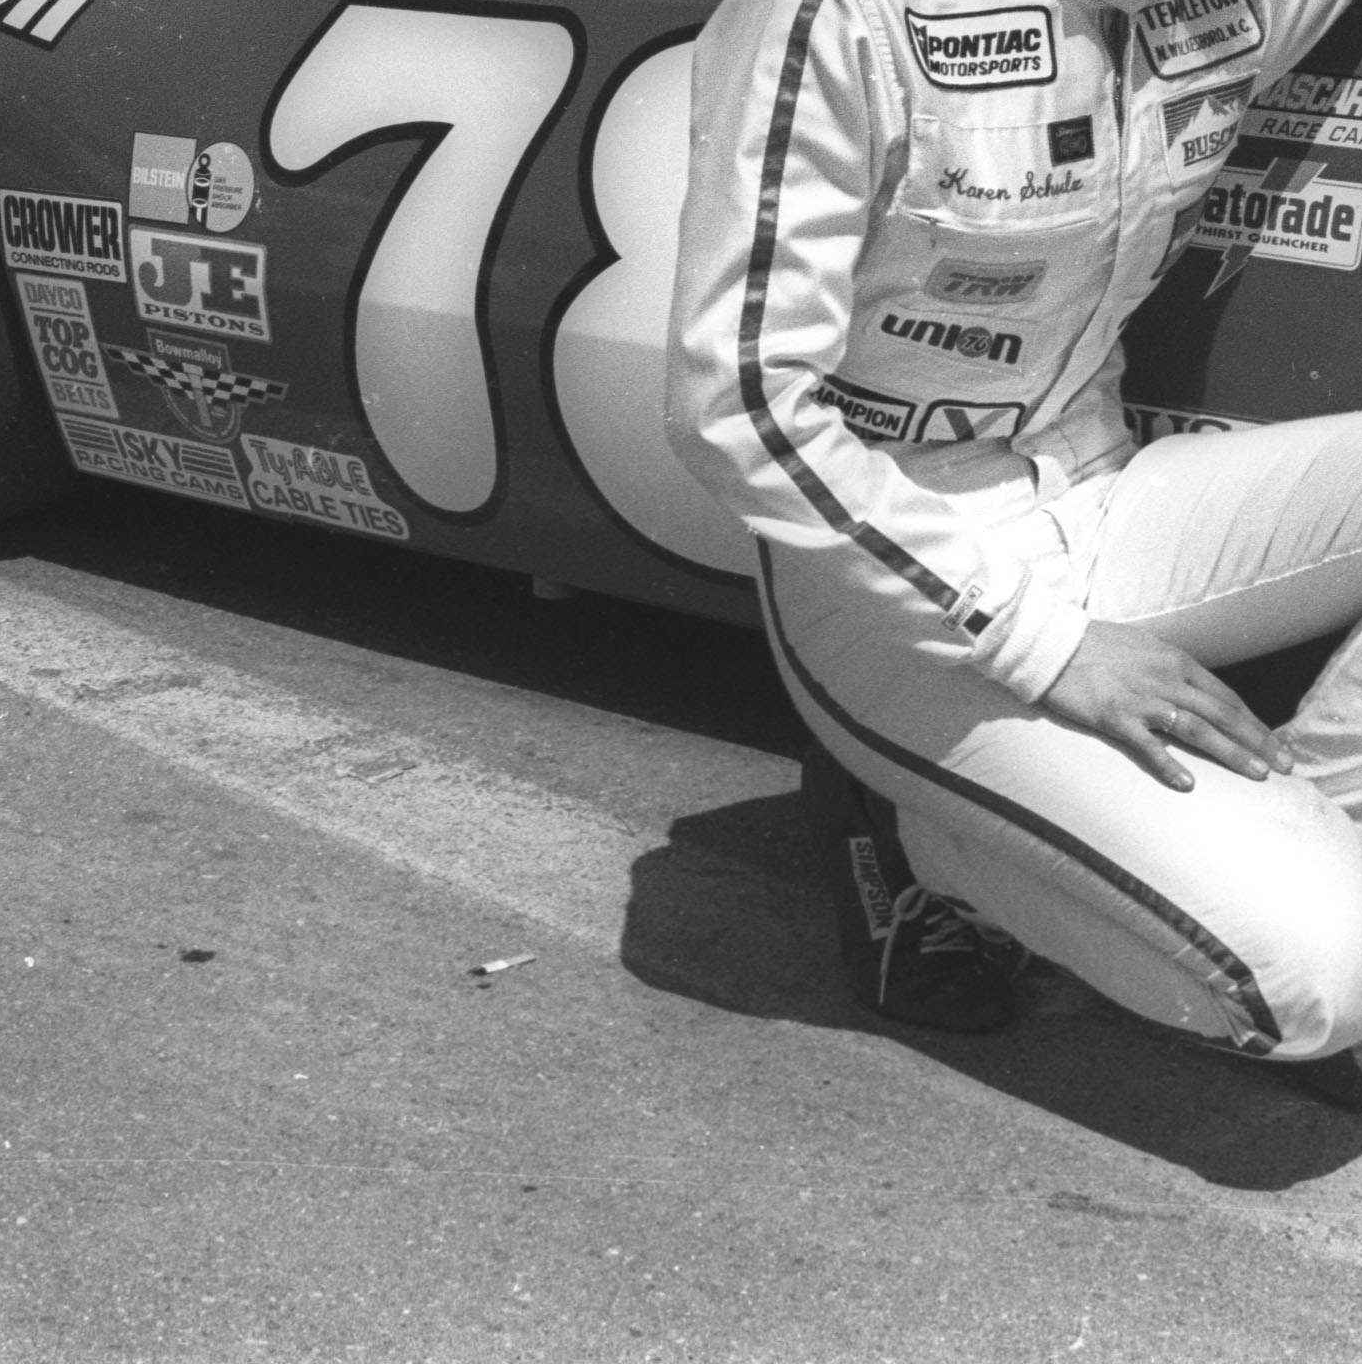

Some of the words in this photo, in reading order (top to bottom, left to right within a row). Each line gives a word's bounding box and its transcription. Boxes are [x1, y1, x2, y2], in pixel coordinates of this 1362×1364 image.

[928, 28, 1042, 59] PONTIAC
[928, 55, 1042, 77] MOTORSPORTS
[1259, 118, 1323, 140] RACE
[132, 166, 185, 189] BILSTEIN
[3, 194, 122, 262] CROWER
[1202, 183, 1355, 242] atorade
[1247, 231, 1329, 253] QUENCHER
[10, 251, 85, 273] CONNECTING
[86, 261, 120, 277] RODS
[139, 236, 262, 321] JE
[24, 282, 83, 311] DAYCO
[33, 315, 89, 348] TOP
[144, 303, 265, 337] PISTONS
[42, 344, 99, 378] COG
[51, 385, 112, 411] BELTS
[810, 385, 902, 433] HAMPION
[111, 428, 183, 471] ISKY
[75, 448, 167, 483] RACING
[170, 471, 244, 502] CAMS
[252, 480, 342, 521] CABLE
[340, 499, 404, 536] TIES
